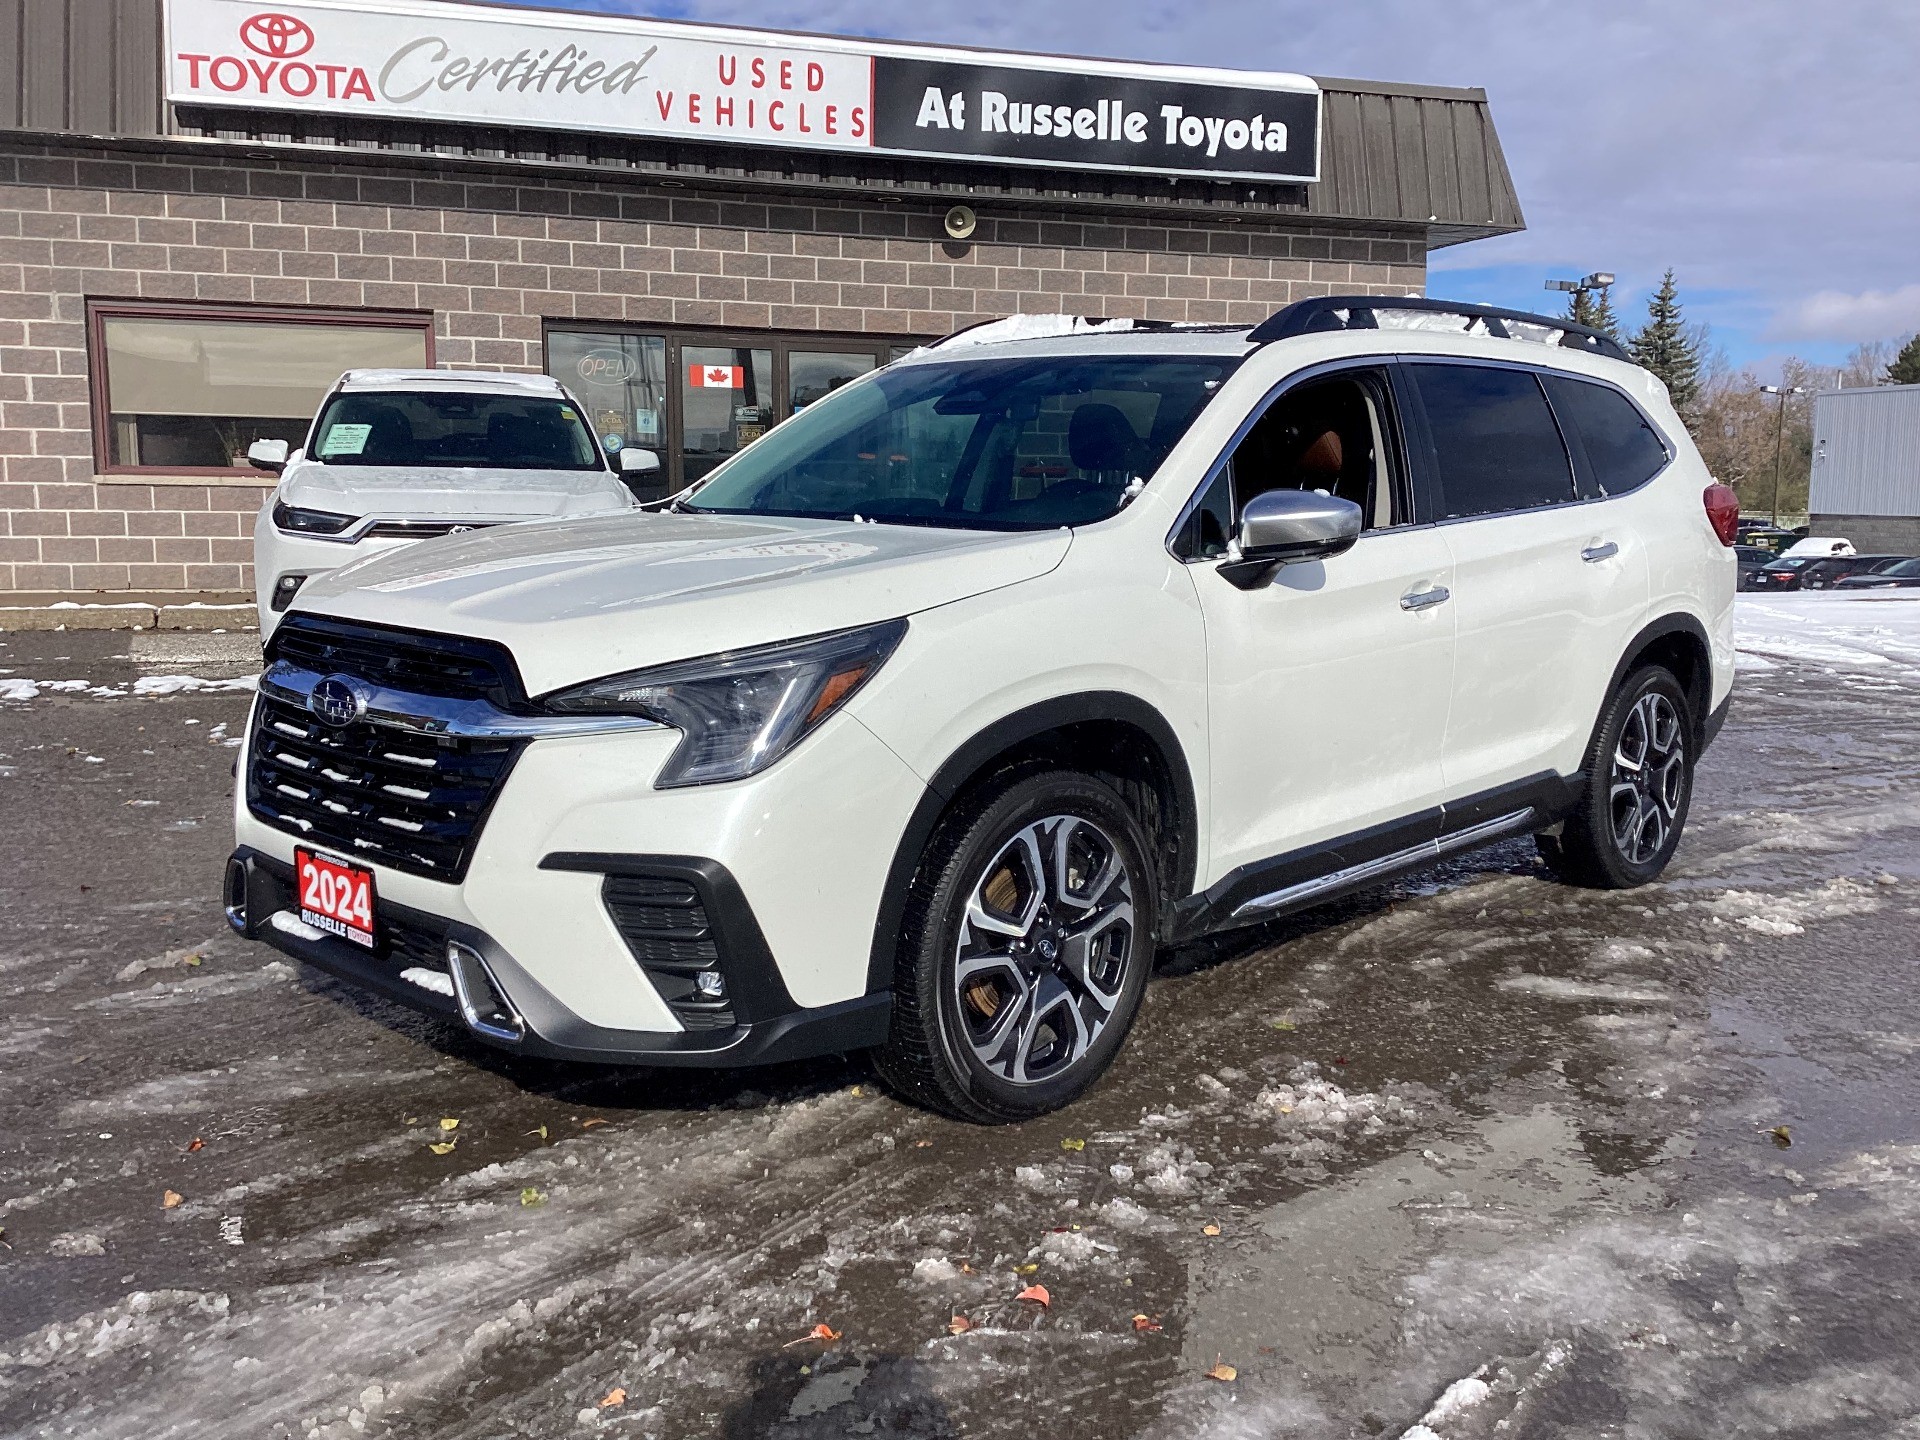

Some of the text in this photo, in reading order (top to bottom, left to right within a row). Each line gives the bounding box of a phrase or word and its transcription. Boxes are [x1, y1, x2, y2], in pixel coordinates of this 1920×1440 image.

[177, 53, 376, 102] TOYOTA
[378, 36, 658, 103] Certified
[718, 54, 824, 92] USED
[656, 90, 866, 138] VEHICLES
[915, 86, 1288, 157] At Russelle Toyota
[580, 358, 630, 377] OPEN
[303, 863, 372, 928] 2024
[301, 908, 372, 945] RUSSELLE TOYOTA
